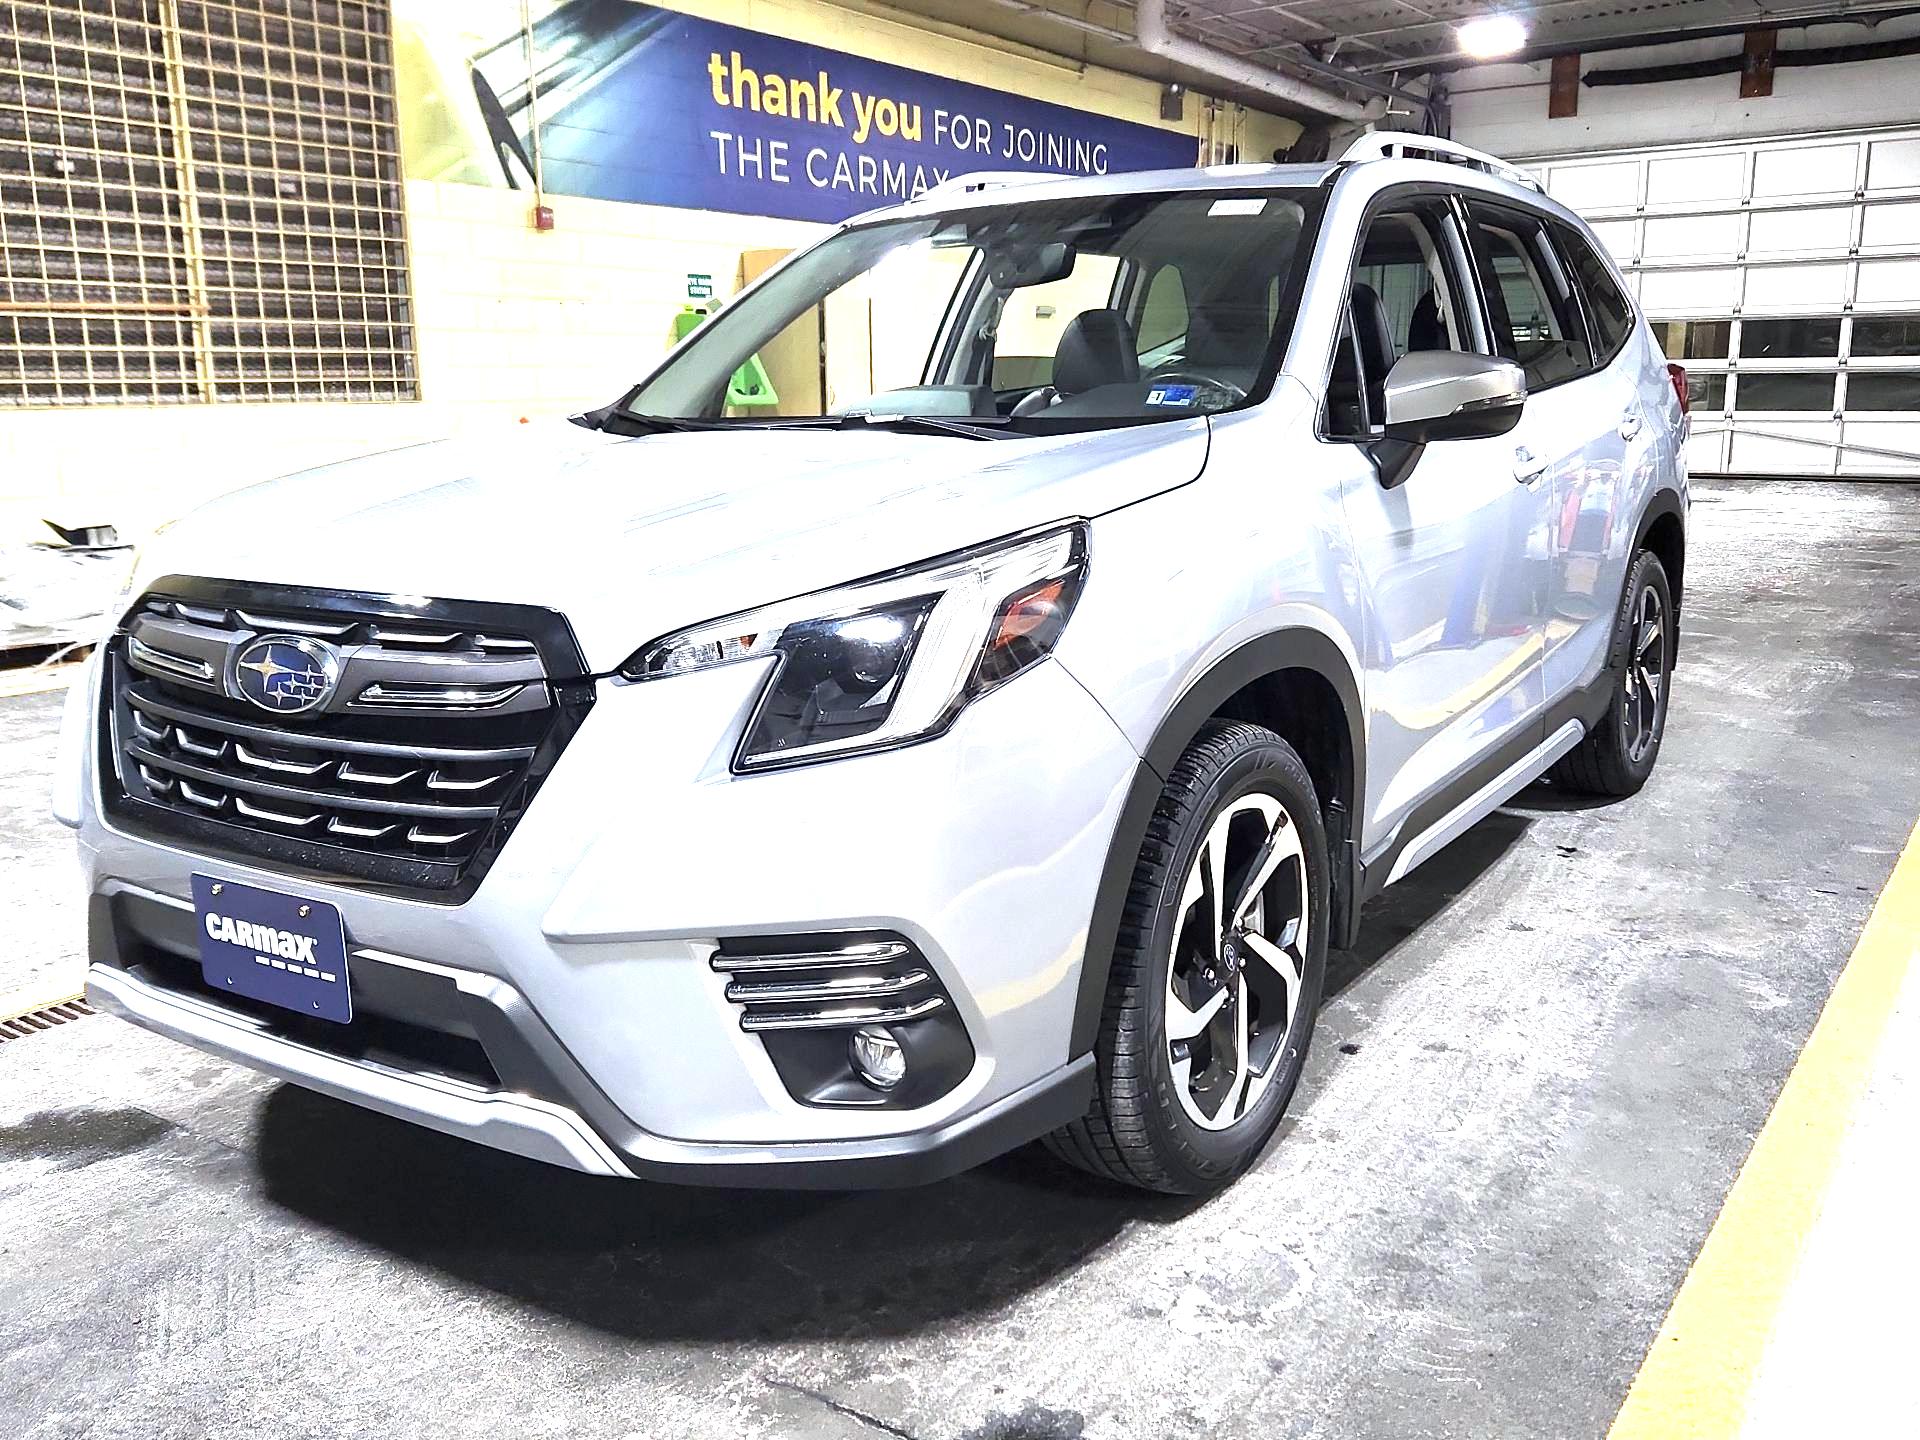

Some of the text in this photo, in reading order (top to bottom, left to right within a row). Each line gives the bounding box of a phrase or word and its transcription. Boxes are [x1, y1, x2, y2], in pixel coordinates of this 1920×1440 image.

[707, 52, 1109, 176] thank you FOR JOINING
[709, 130, 791, 183] THE
